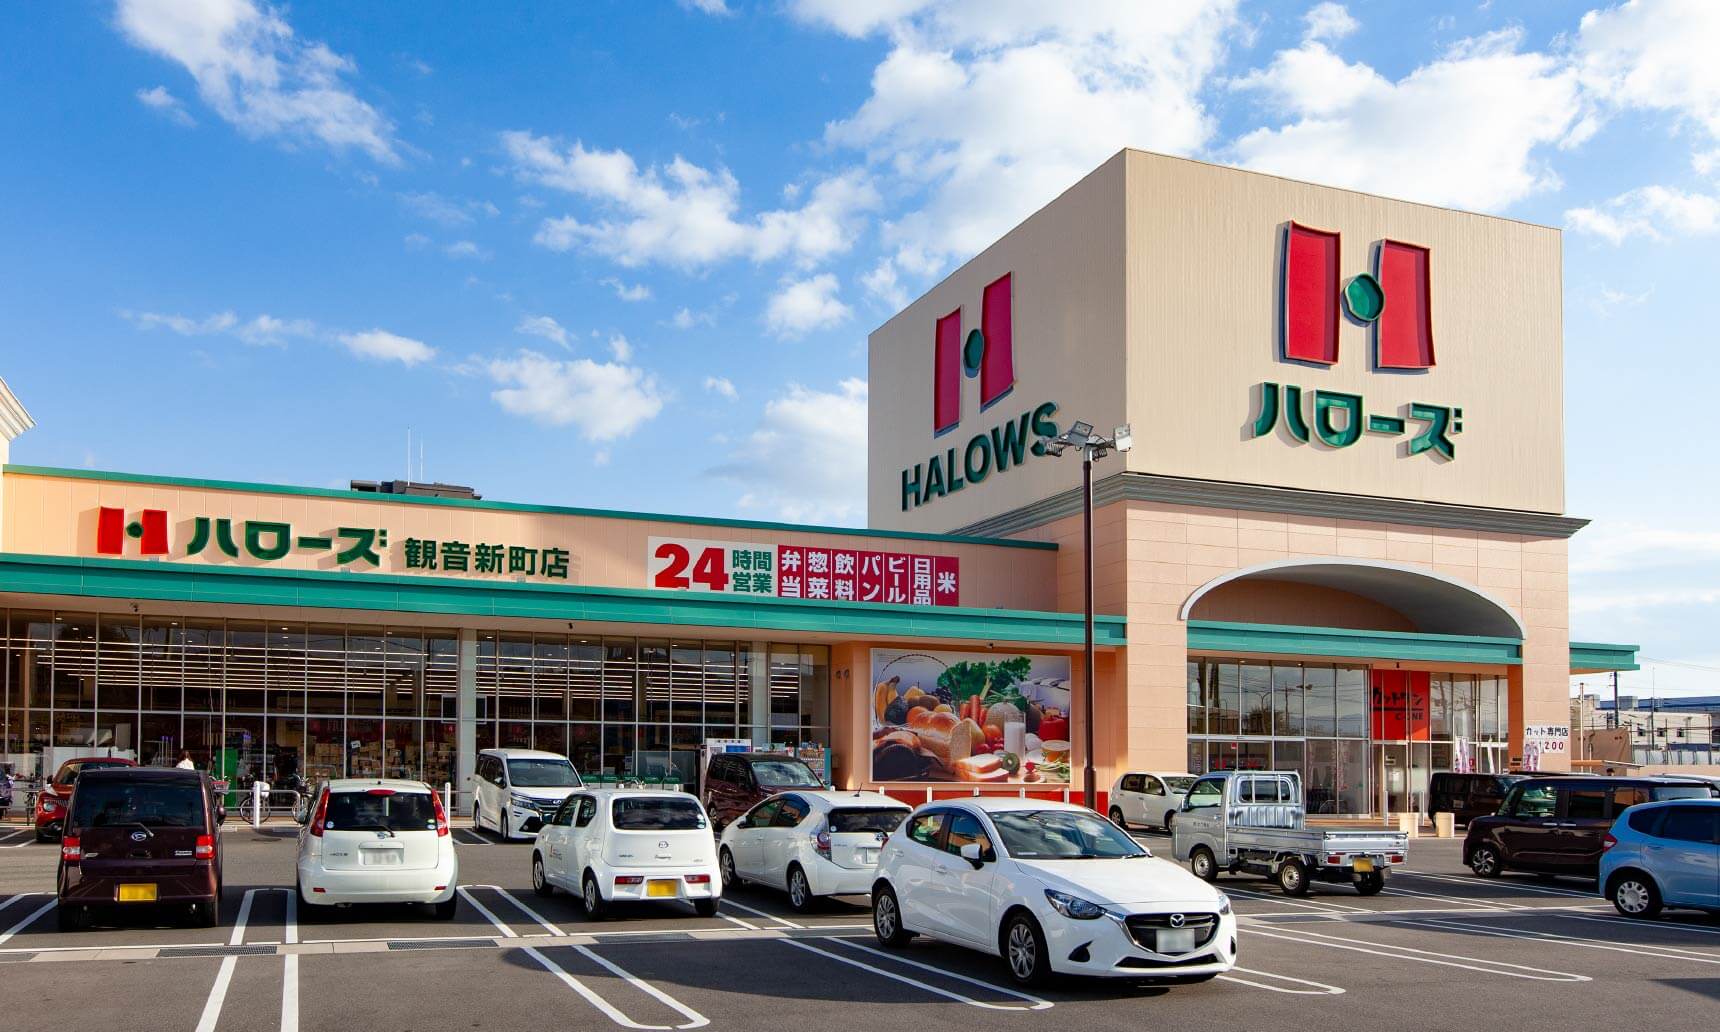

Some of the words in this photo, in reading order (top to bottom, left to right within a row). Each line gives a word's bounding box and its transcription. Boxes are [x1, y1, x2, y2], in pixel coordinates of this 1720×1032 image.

[1253, 381, 1462, 461] ハローズ
[902, 401, 1059, 512] HALOWS
[186, 516, 388, 567] ハローズ
[404, 537, 570, 579] 観音新町店
[654, 543, 729, 591] 24
[781, 549, 802, 598] 弁当
[807, 551, 829, 598] 惣菜
[834, 552, 855, 601] 飲料
[861, 554, 881, 601] パン
[887, 556, 906, 603] ビール
[913, 558, 932, 605] 日用品
[937, 571, 957, 594] 米
[1525, 727, 1569, 737] カット専門店
